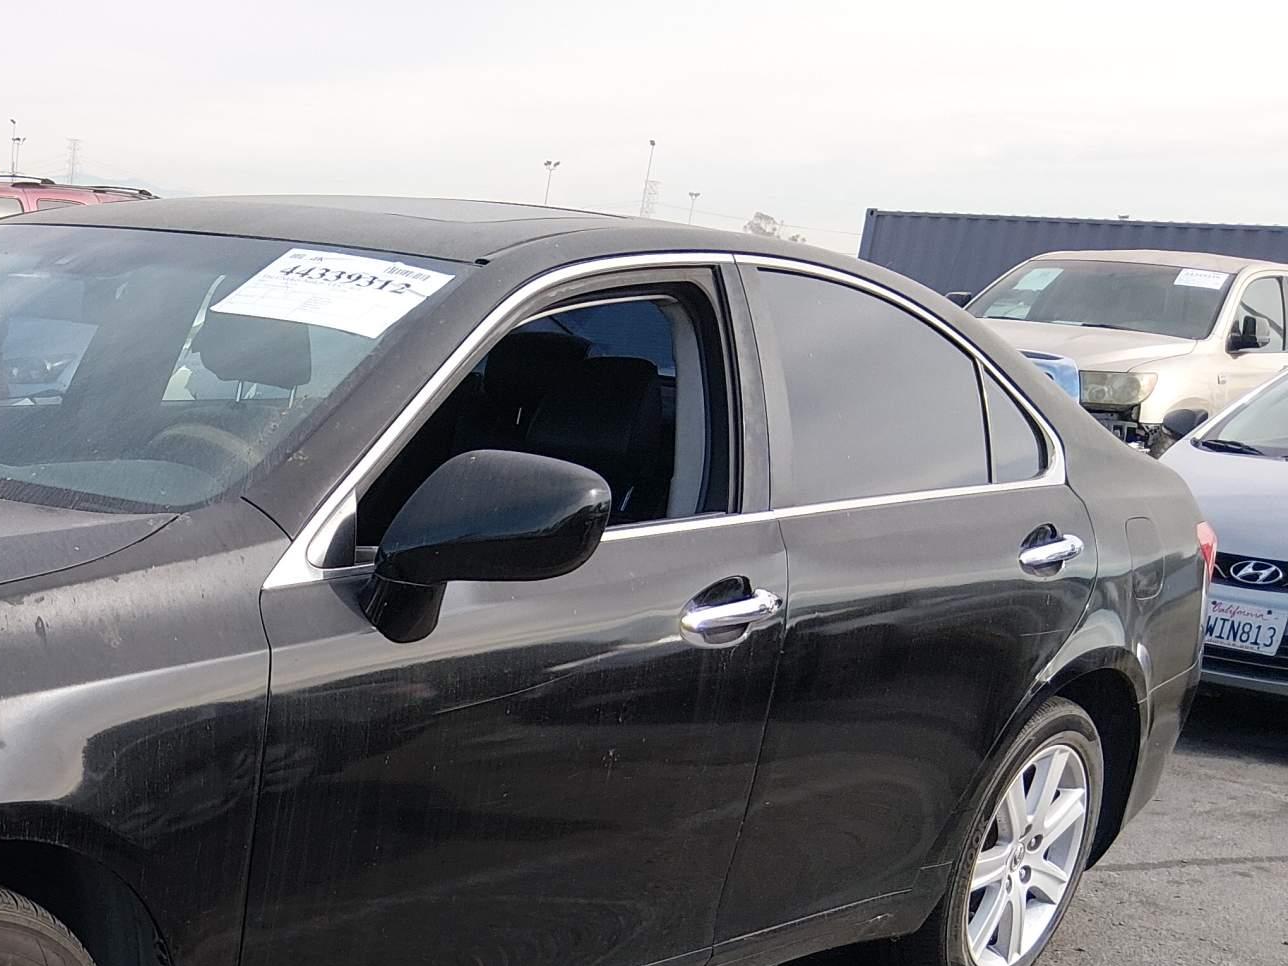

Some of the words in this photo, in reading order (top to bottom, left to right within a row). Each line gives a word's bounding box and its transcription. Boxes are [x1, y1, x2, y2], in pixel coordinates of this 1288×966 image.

[280, 264, 412, 295] 44339312
[1212, 601, 1265, 619] California
[1205, 615, 1277, 648] WIN813
